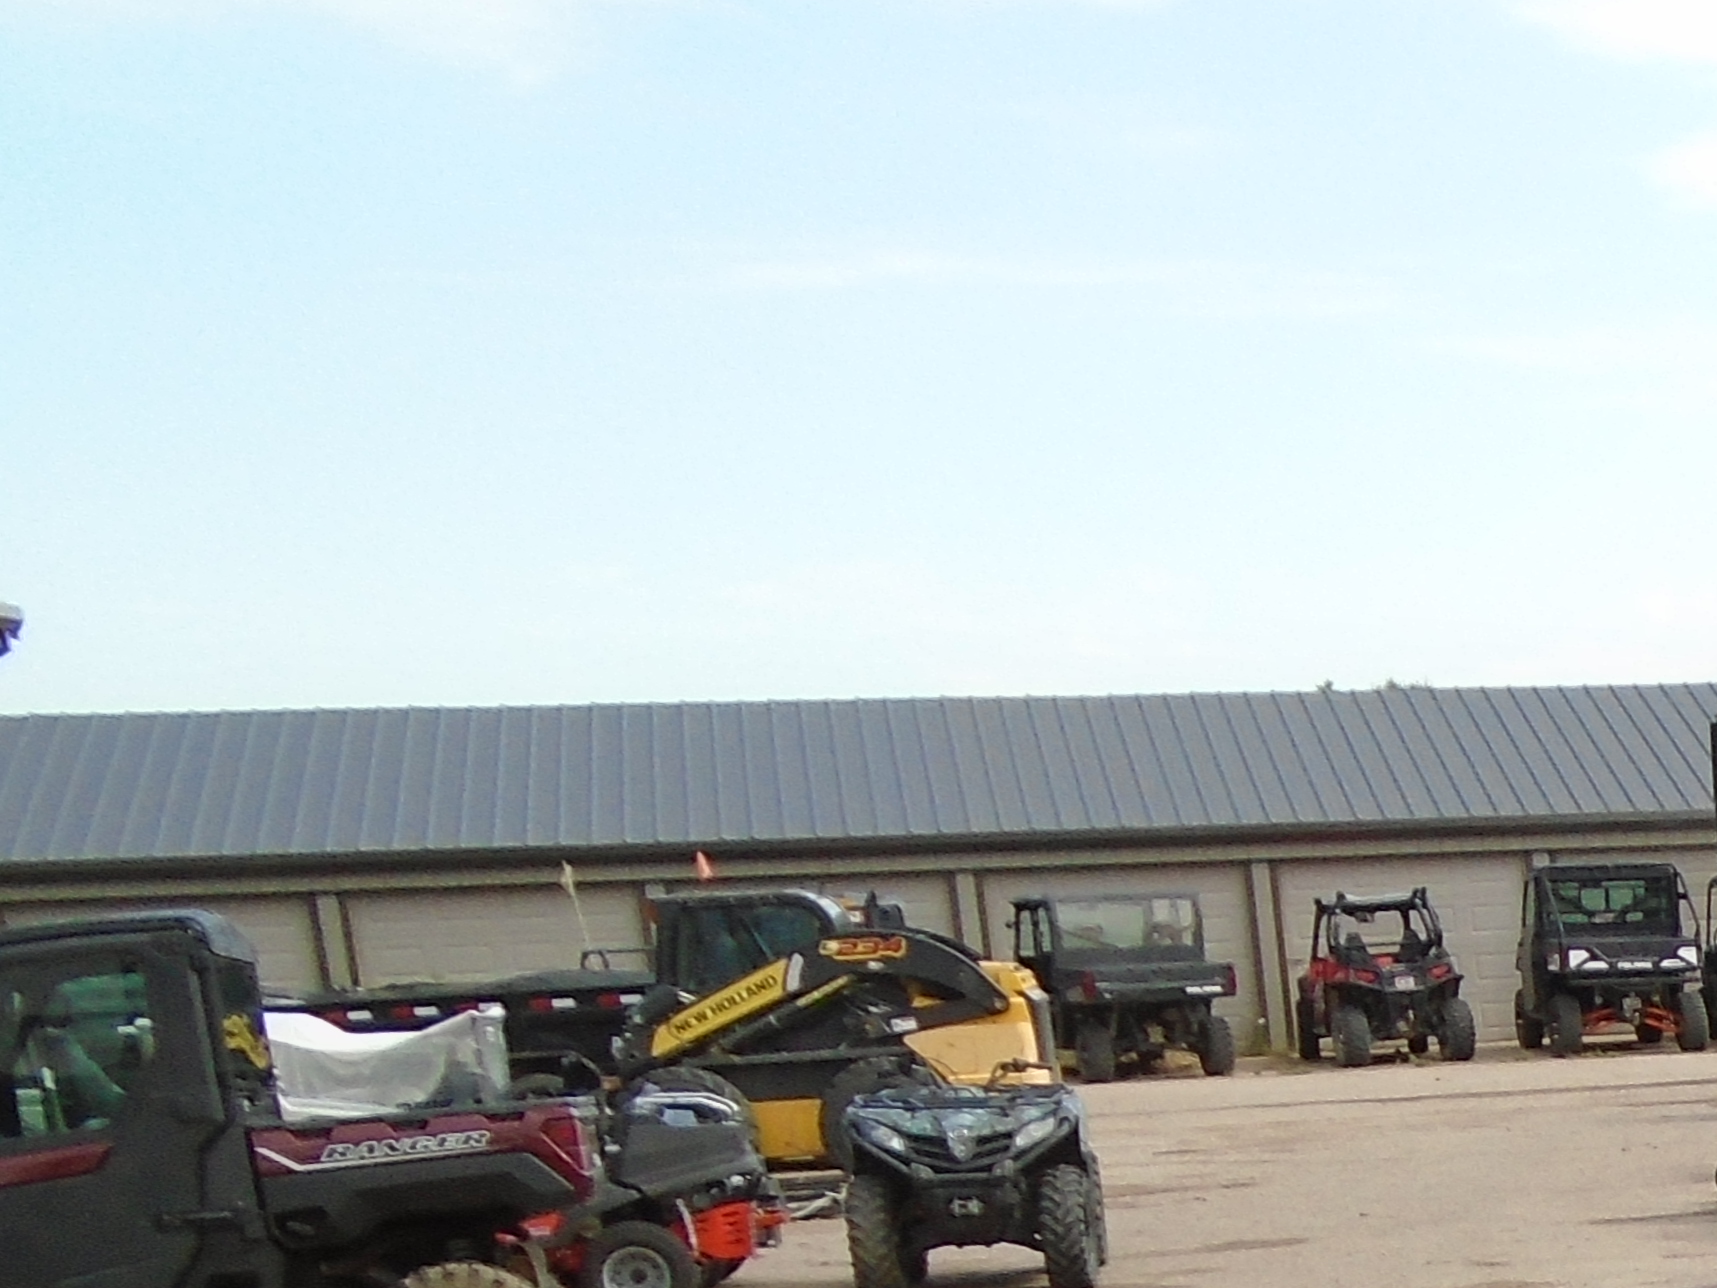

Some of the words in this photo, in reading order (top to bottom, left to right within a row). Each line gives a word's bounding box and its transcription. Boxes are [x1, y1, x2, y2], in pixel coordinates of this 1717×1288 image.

[674, 1006, 711, 1035] NEW
[711, 974, 780, 1017] HOLLAND
[320, 1130, 490, 1162] RANGER
